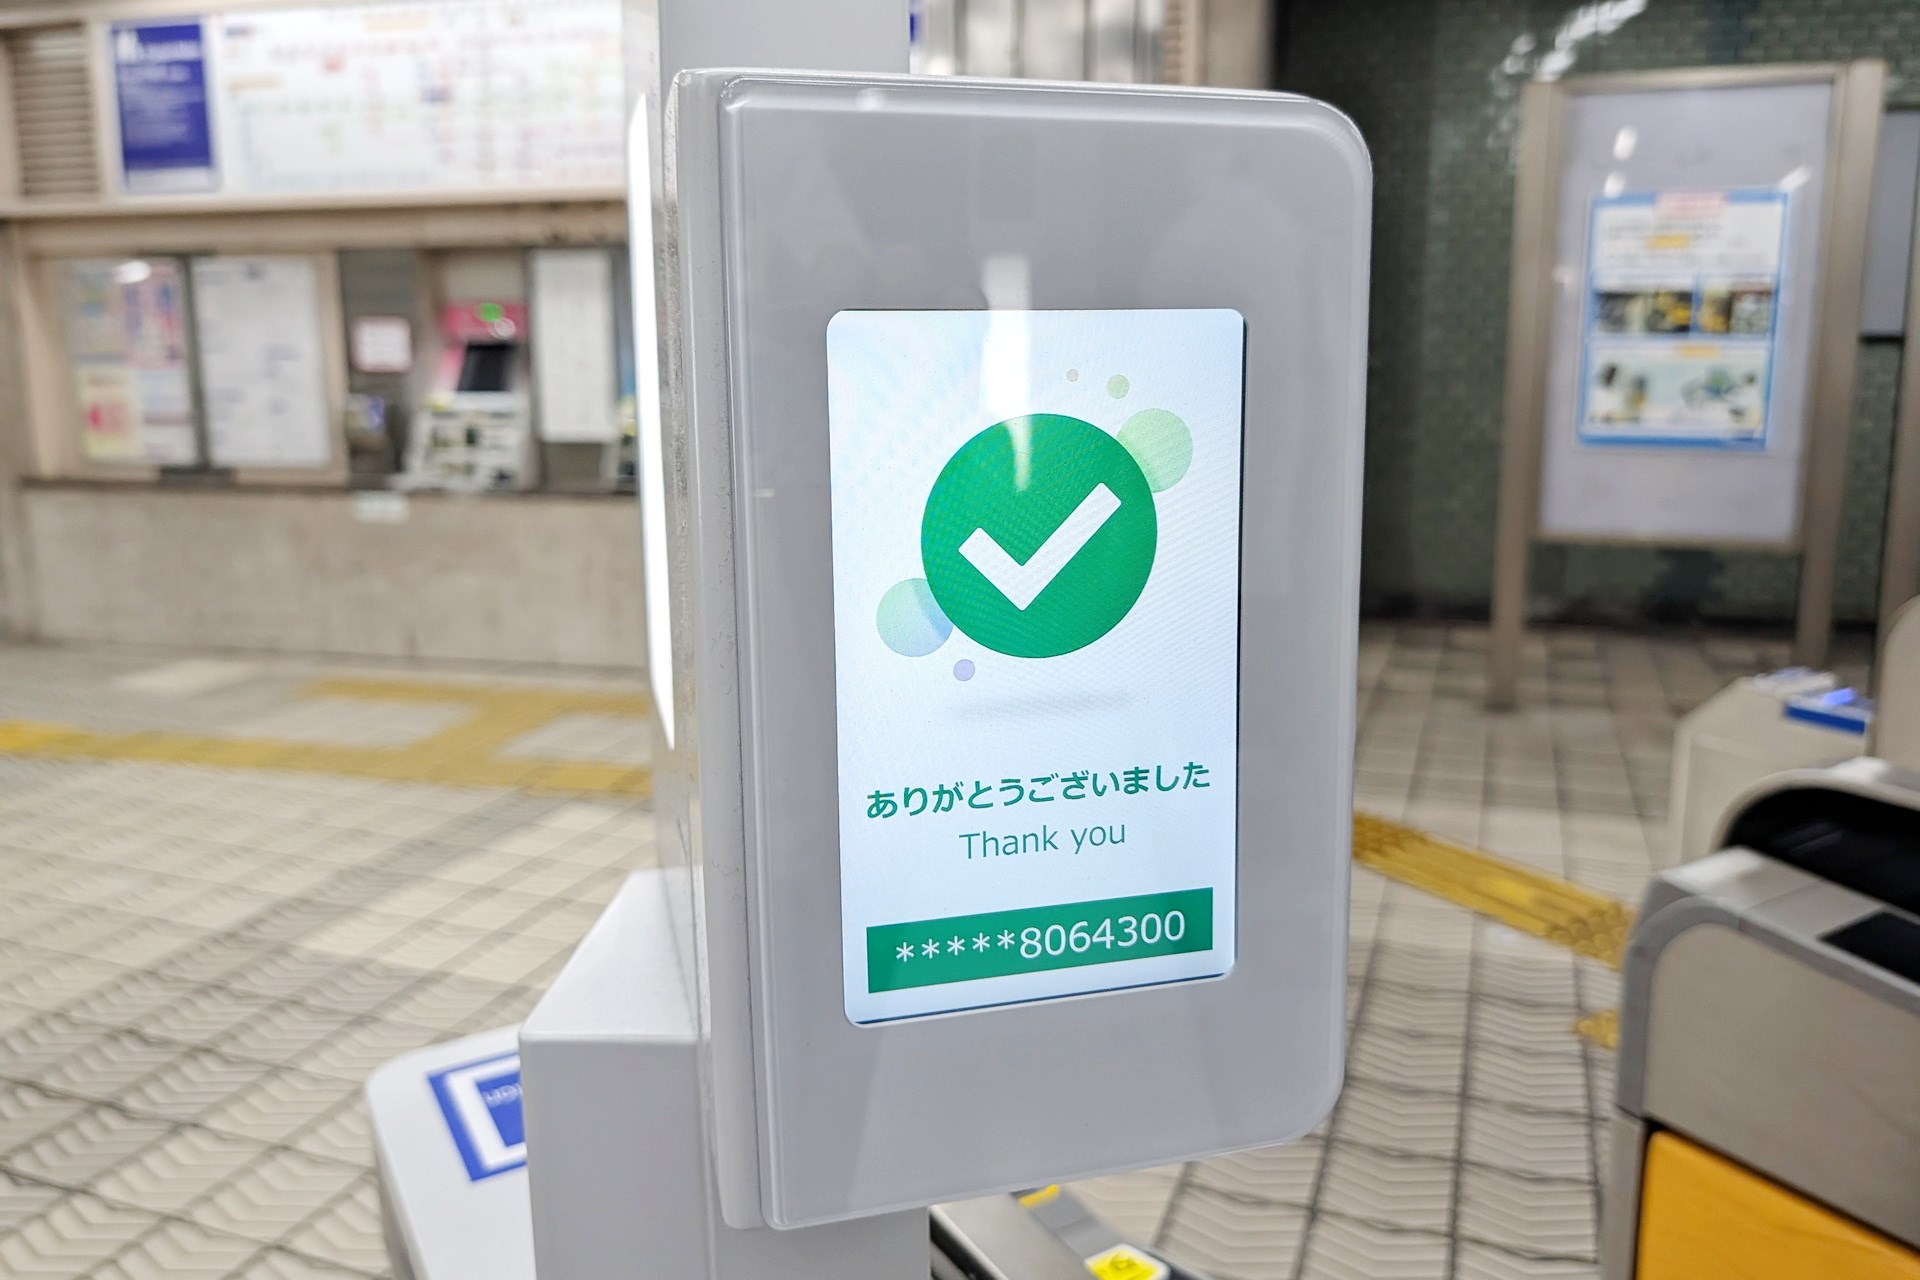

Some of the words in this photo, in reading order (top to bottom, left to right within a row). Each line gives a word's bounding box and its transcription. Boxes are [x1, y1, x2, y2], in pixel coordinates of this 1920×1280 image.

[866, 761, 1211, 819] ありがとうございました
[959, 825, 1059, 859] Thank
[1070, 823, 1126, 854] you
